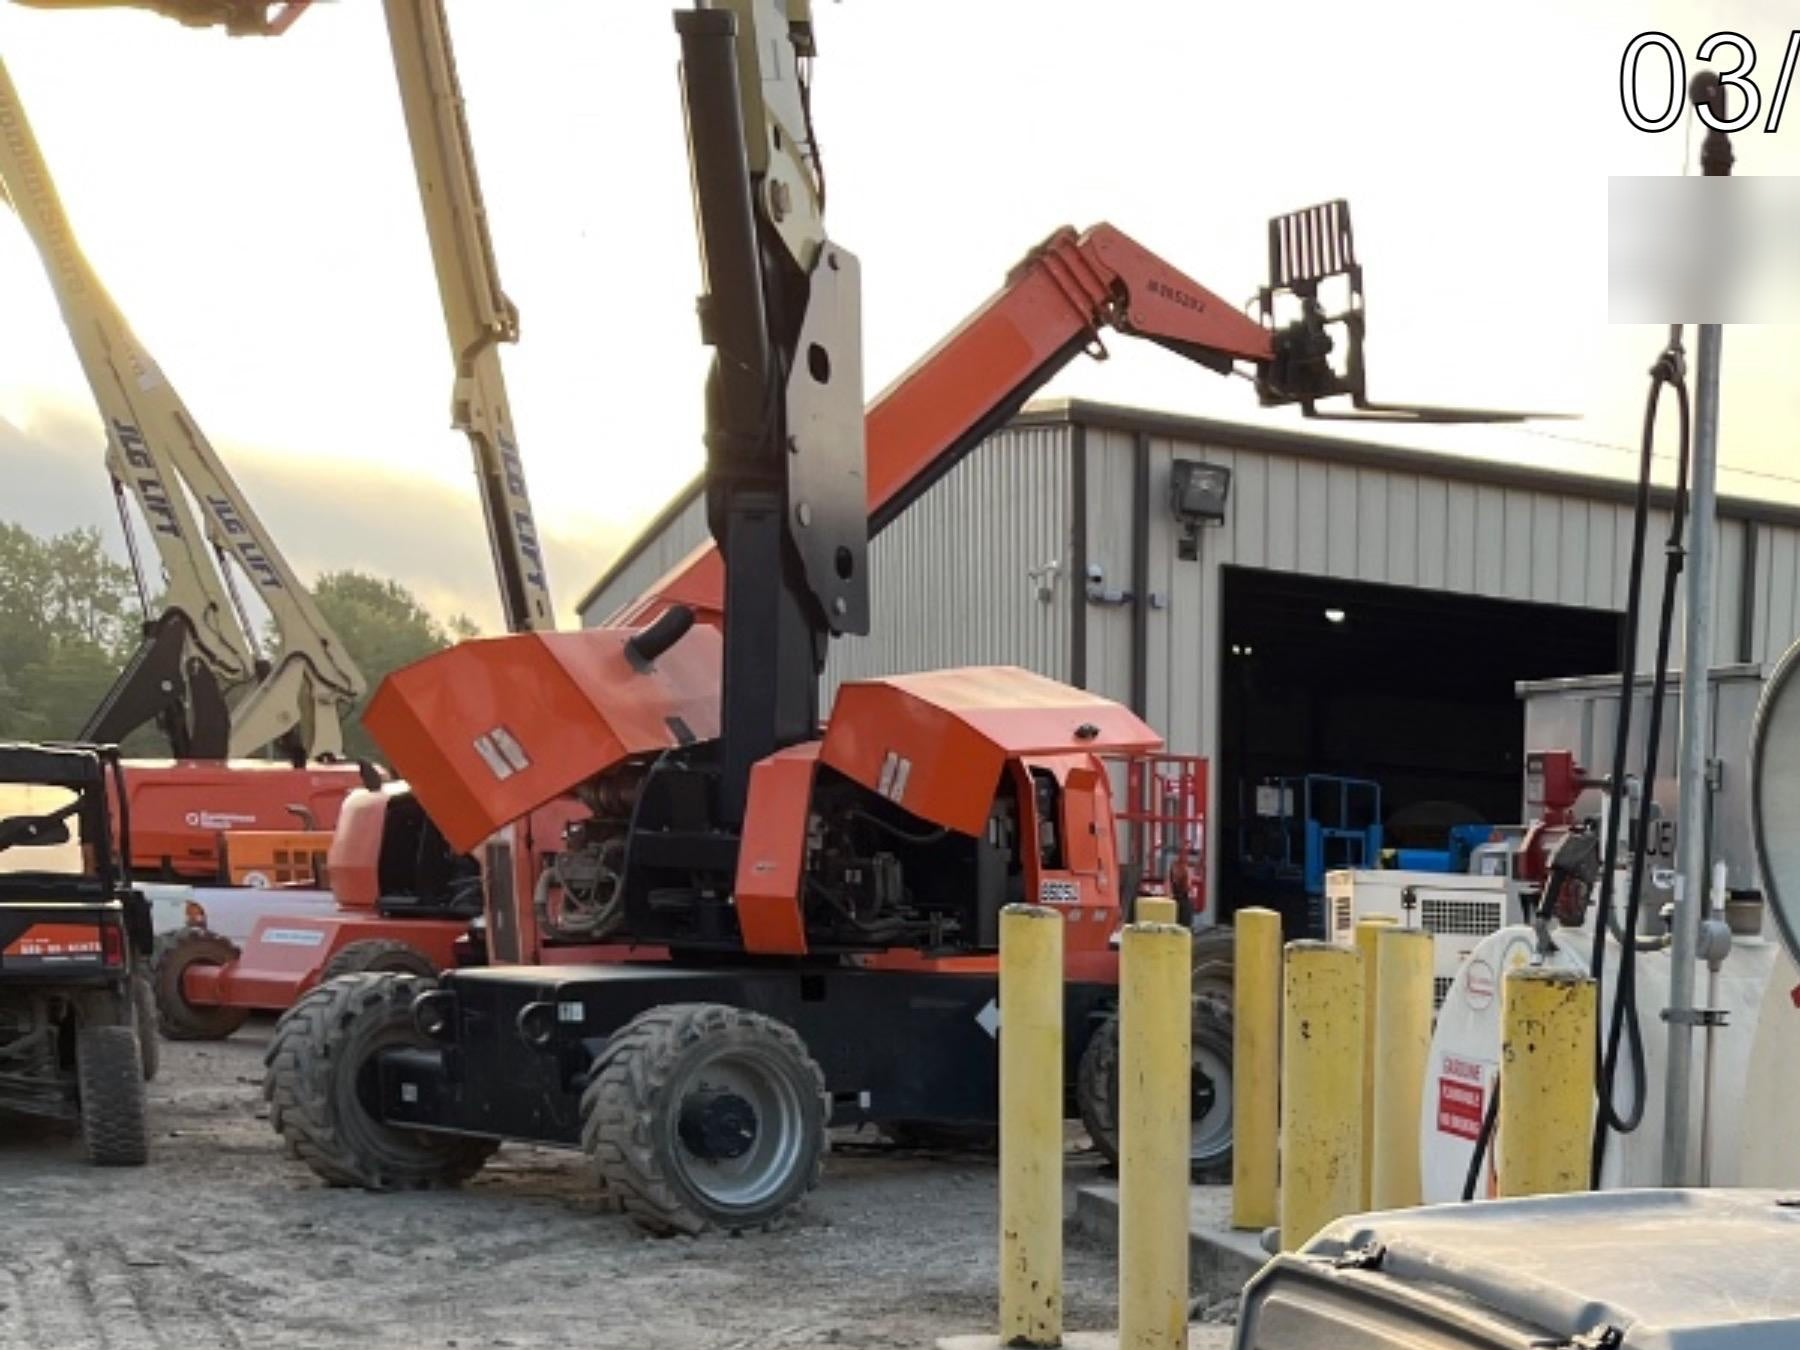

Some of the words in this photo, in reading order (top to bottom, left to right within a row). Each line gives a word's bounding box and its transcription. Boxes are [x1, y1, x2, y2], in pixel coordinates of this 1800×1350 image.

[112, 416, 155, 470] JLG
[137, 478, 181, 538] LIFT
[497, 429, 526, 499] JLG
[513, 510, 547, 593] LIFT
[206, 494, 247, 535] JLG
[236, 542, 283, 589] LIFT
